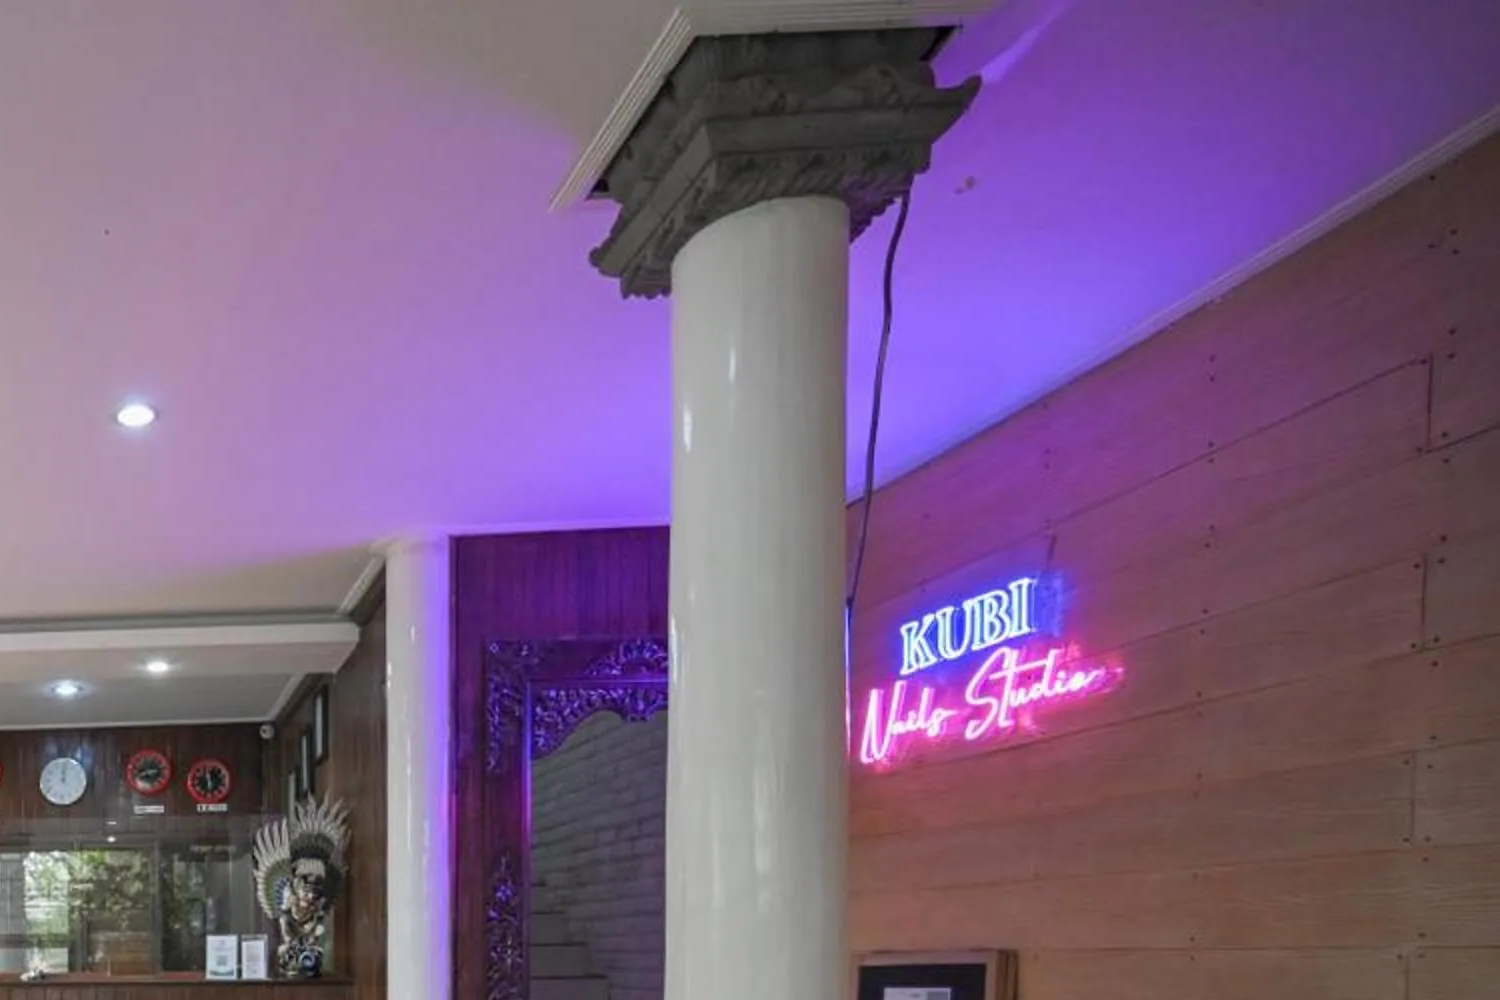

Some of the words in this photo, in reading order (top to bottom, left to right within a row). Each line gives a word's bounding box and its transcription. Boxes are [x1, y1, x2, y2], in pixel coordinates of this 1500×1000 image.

[899, 577, 1038, 676] KUBI
[859, 680, 956, 765] Nails
[964, 645, 1125, 741] Studio
